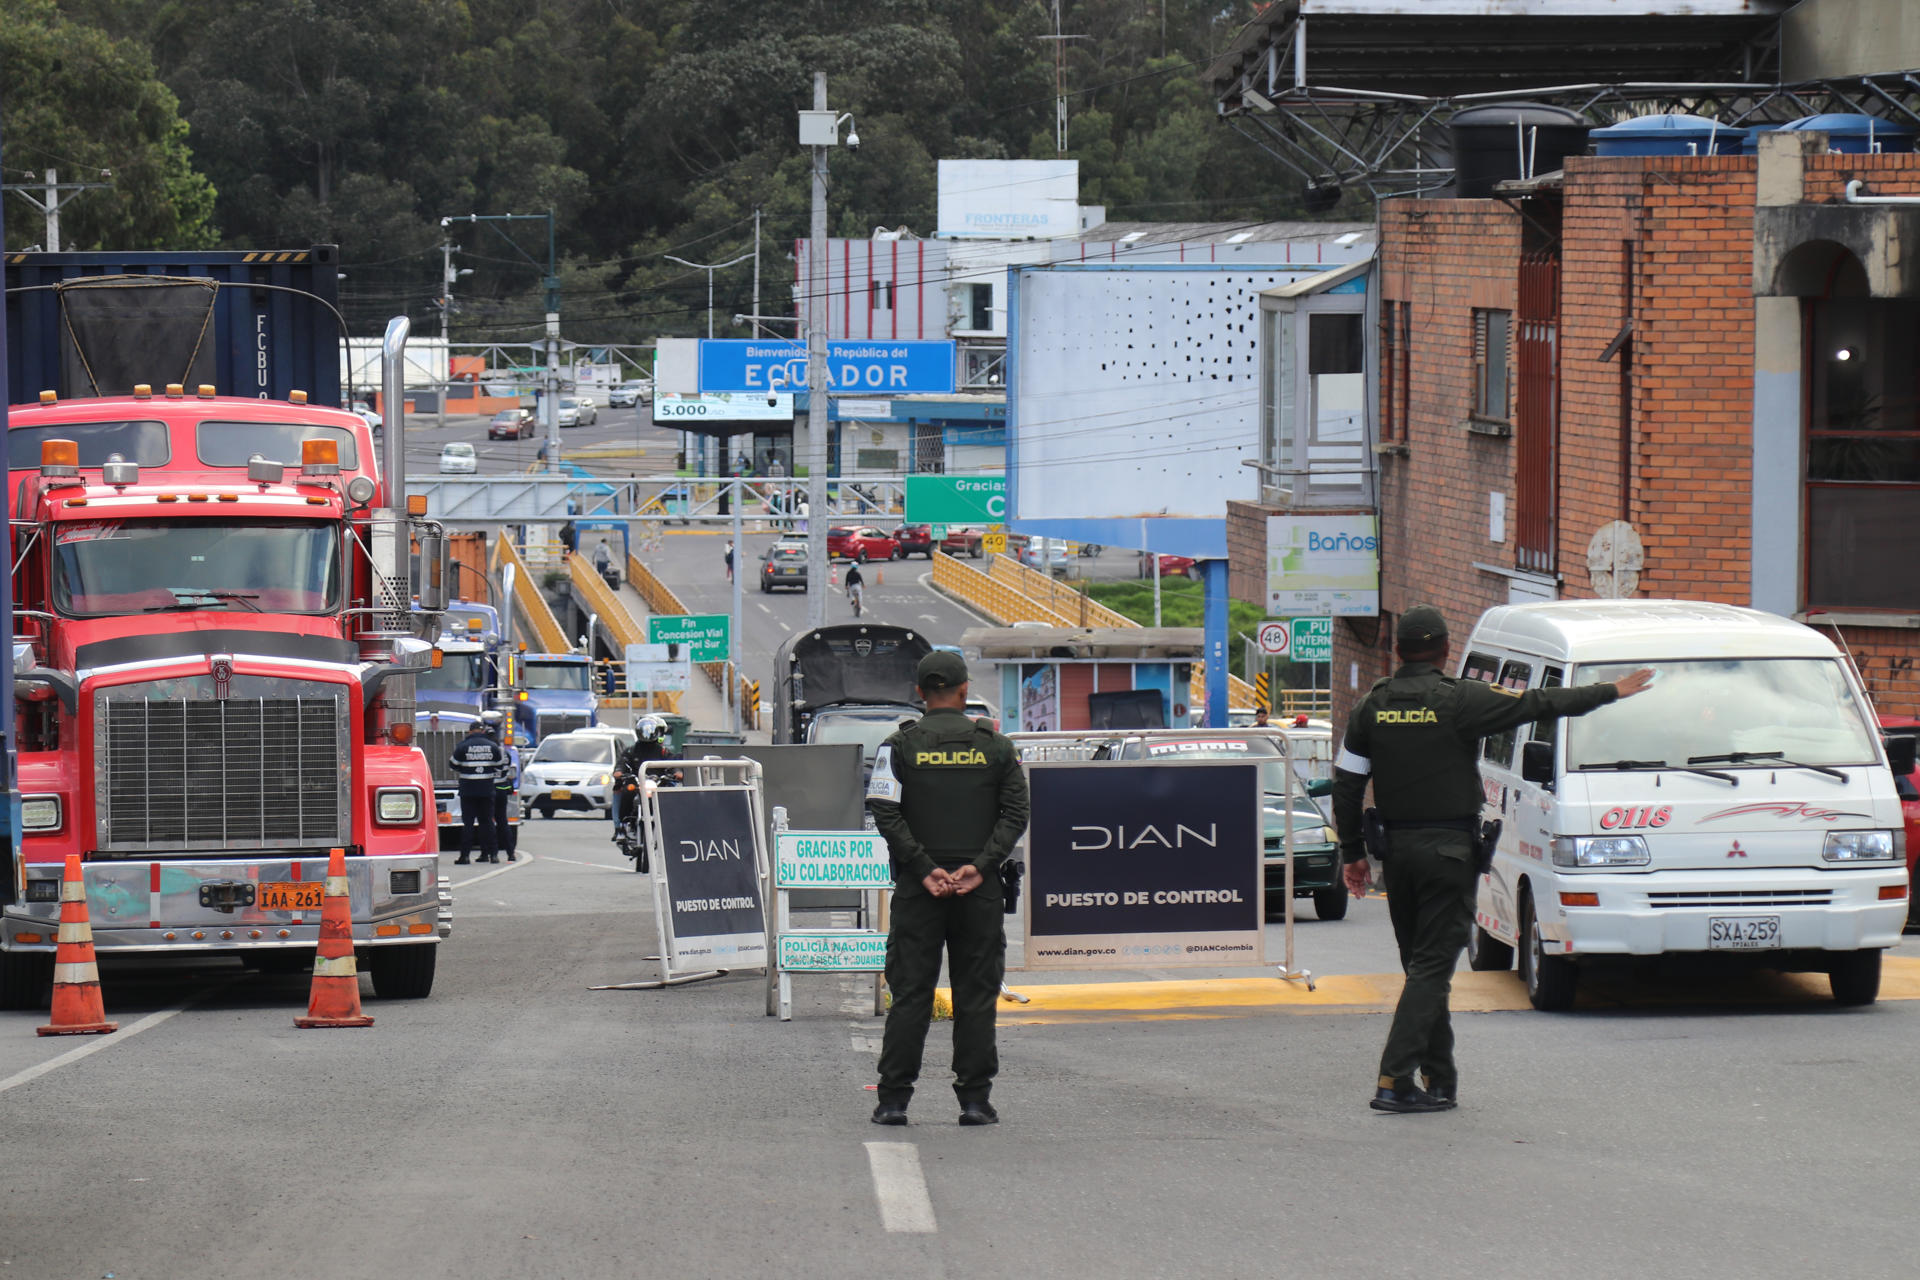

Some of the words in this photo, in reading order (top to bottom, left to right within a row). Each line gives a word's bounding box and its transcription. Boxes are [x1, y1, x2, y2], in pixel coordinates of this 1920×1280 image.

[965, 213, 1049, 225] FRONTERAS
[834, 347, 888, 359] República
[891, 347, 908, 358] del
[662, 405, 707, 416] 5.000
[985, 535, 1004, 546] 40
[1309, 531, 1377, 551] Baños
[681, 619, 697, 628] Fin
[657, 630, 705, 640] Concesion
[706, 628, 723, 638] Vial
[1264, 631, 1282, 643] 48
[704, 640, 720, 648] Sur
[1376, 706, 1439, 723] POLICÍA
[916, 748, 988, 765] POLICÍA
[1600, 805, 1674, 830] 0118
[1072, 823, 1217, 850] DIAN
[680, 839, 741, 863] DIAN
[797, 840, 847, 858] GRACIAS
[850, 840, 873, 858] POR
[781, 863, 796, 881] SU
[800, 863, 889, 881] COLABORACION
[676, 899, 708, 912] PUESTO
[709, 898, 721, 911] DE
[721, 896, 755, 910] CONTROL
[1046, 892, 1119, 907] PUESTO
[1124, 891, 1149, 905] DE
[1153, 889, 1243, 904] CONTROL
[1037, 948, 1117, 957] www.dian.gov.co
[1186, 944, 1254, 953] @DIANColombia
